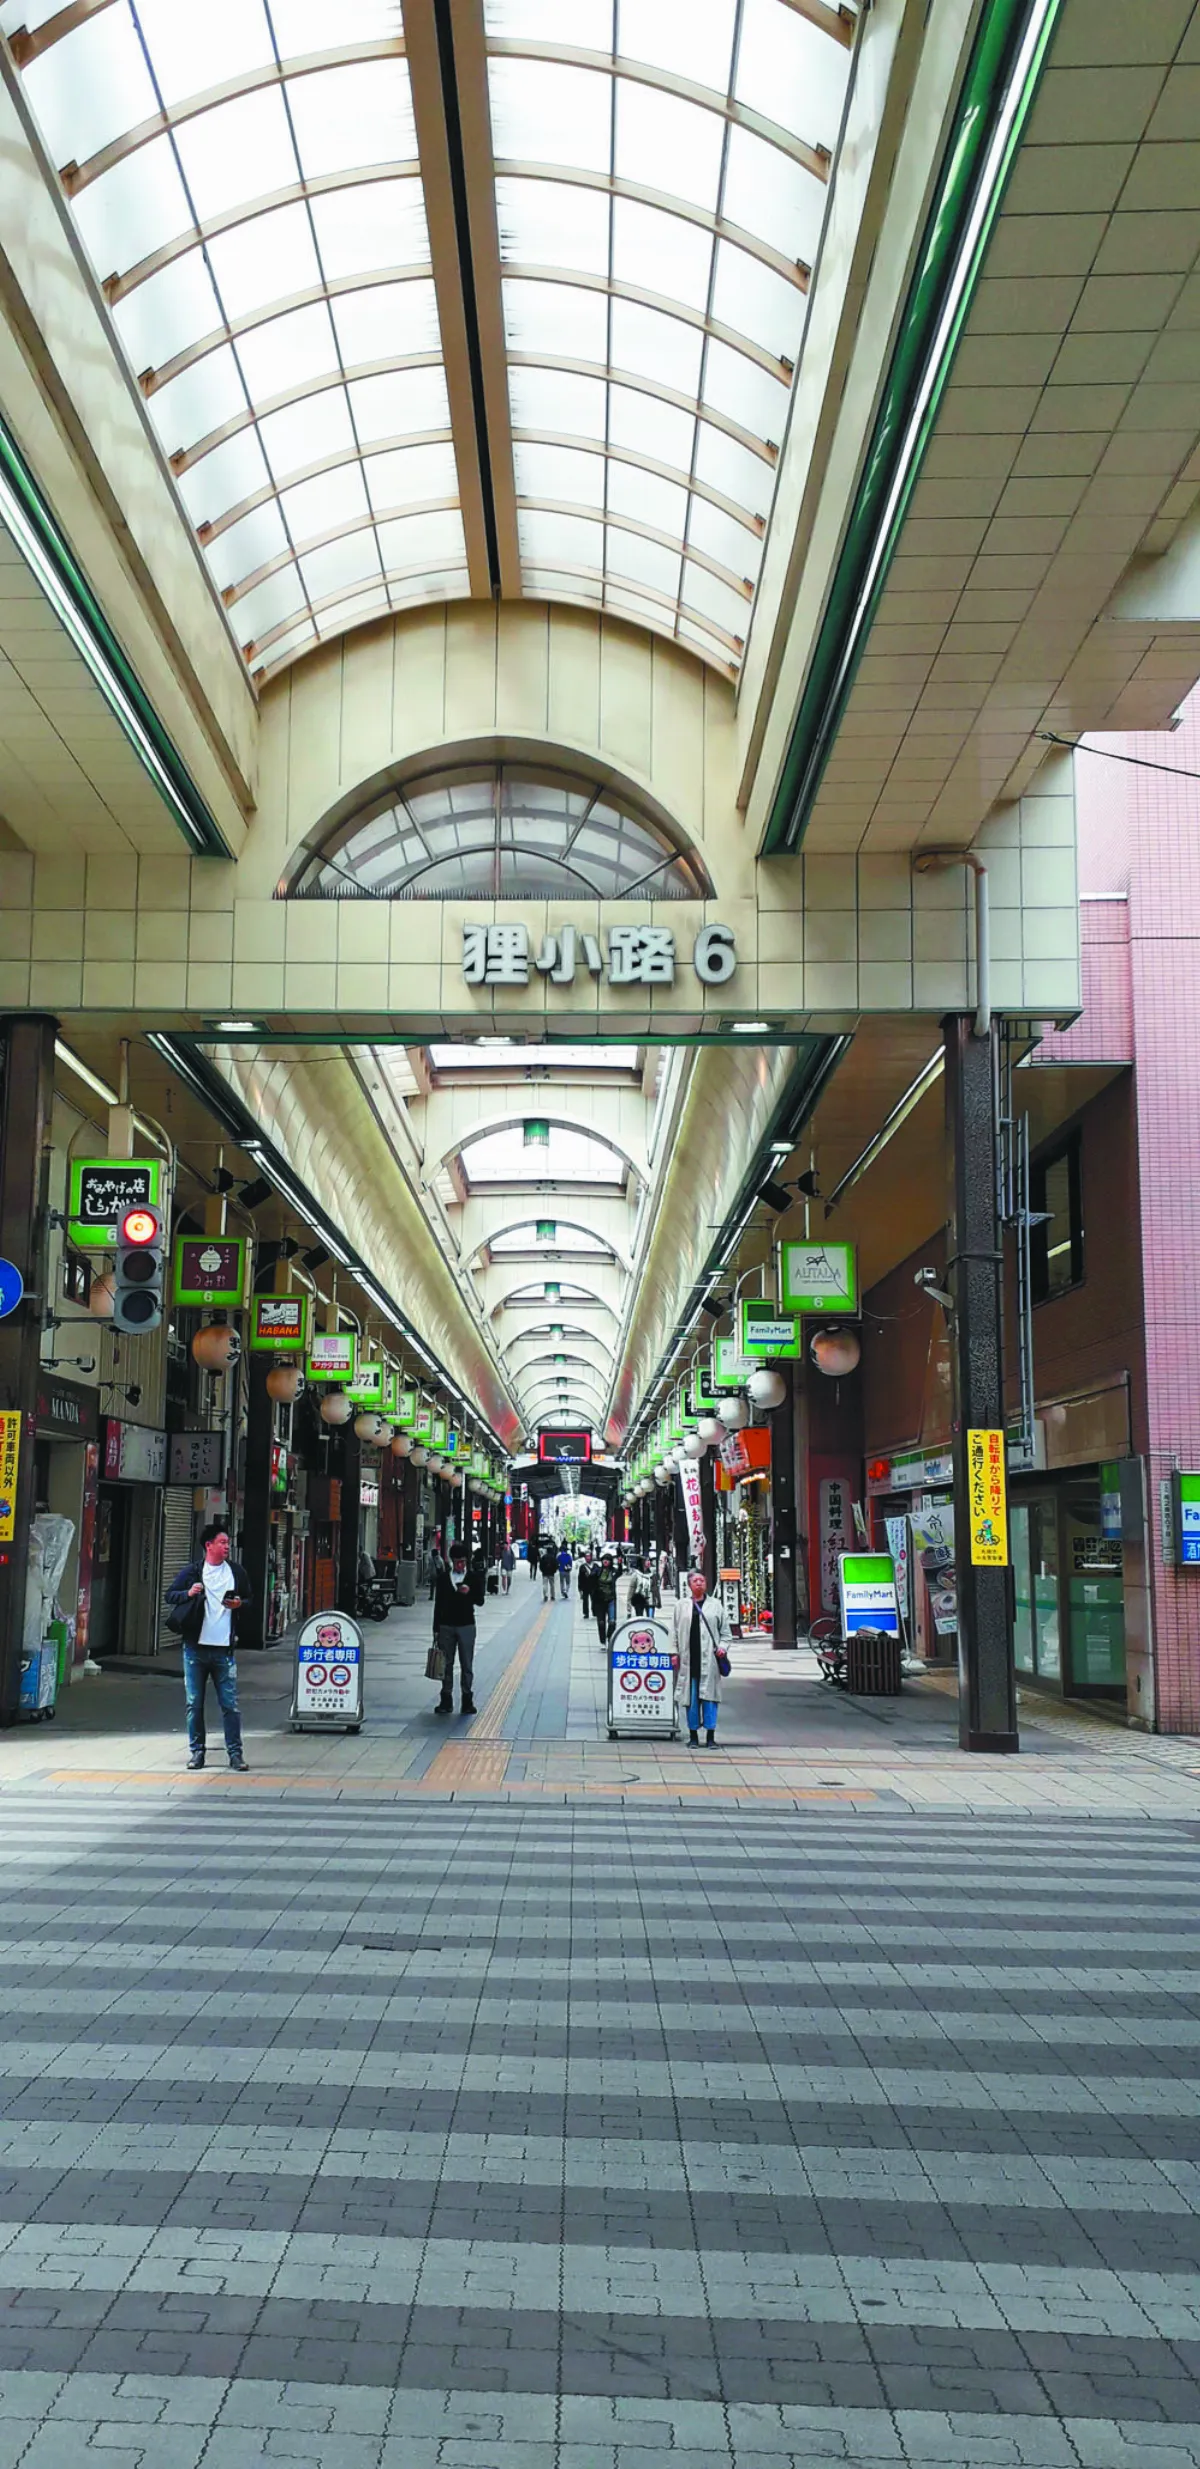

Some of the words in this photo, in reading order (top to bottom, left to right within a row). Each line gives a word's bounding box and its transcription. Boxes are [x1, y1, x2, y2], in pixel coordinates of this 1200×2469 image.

[86, 1178, 145, 1194] おみやげの店
[203, 1291, 213, 1302] 6
[814, 1297, 824, 1308] 6
[259, 1326, 299, 1335] HABANA
[750, 1326, 792, 1336] FamilyMart
[766, 1345, 775, 1354] 6
[52, 1398, 79, 1424] MANDA
[3, 1418, 17, 1489] 許可車両以外
[972, 1434, 985, 1517] ご通行ください
[988, 1434, 1001, 1516] 自転車から降りて
[828, 1482, 842, 1530] 中国料理
[846, 1590, 893, 1600] FamilyMart
[303, 1649, 356, 1662] 歩行者専用
[616, 1655, 670, 1668] 歩行者専用
